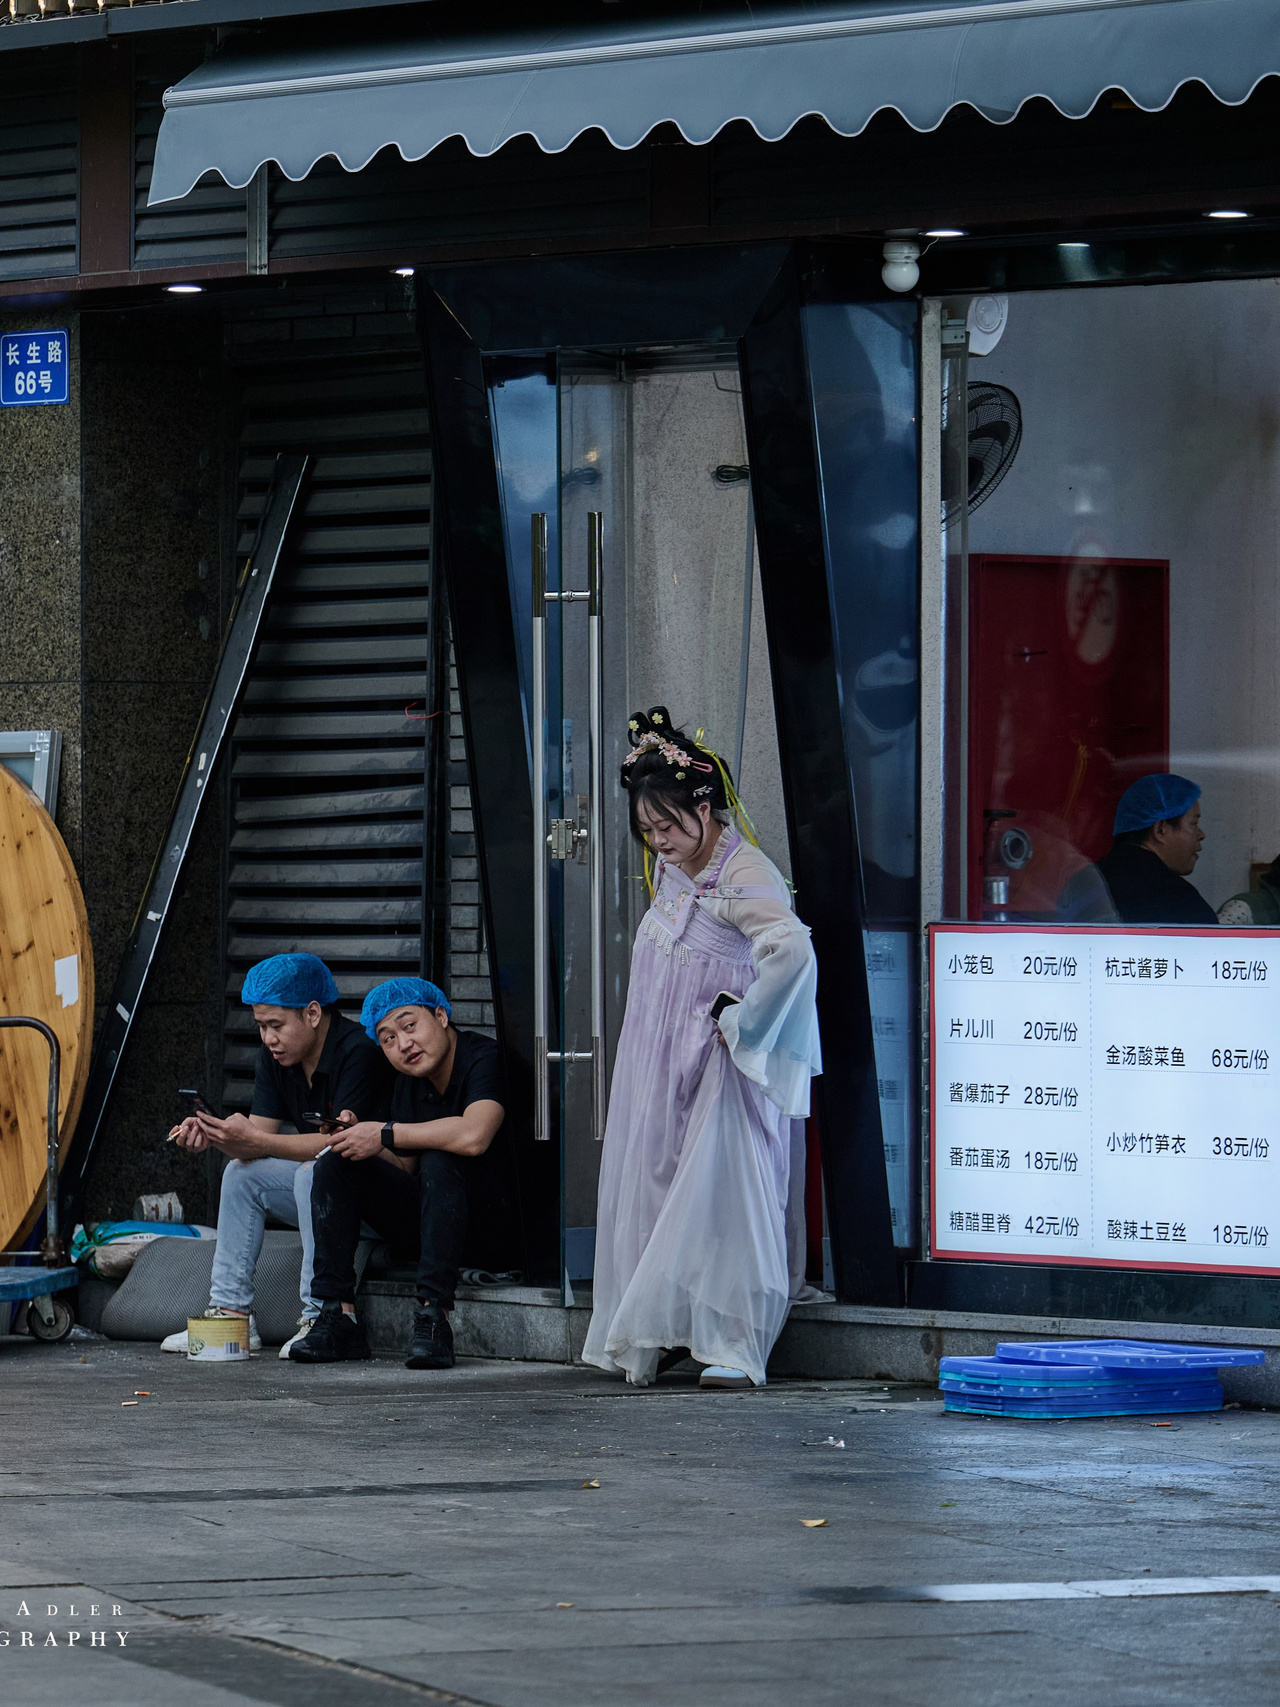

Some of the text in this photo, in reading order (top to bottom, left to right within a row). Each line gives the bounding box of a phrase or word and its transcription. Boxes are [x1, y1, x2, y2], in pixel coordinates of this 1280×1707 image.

[6, 340, 62, 366] 长生路
[15, 370, 52, 395] 66号
[949, 954, 1078, 977] 小笼包 20元/份
[1105, 957, 1268, 981] 杭式酱萝卜 18元/份
[949, 1018, 1078, 1042] 片儿川 20元/份
[1106, 1045, 1270, 1070] 金汤酸菜鱼 68元/份
[949, 1082, 1079, 1107] 酱爆茄子 28元/份
[1106, 1132, 1270, 1158] 小炒竹笋衣 38元/份
[949, 1147, 1079, 1172] 番茄蛋汤 18元/份
[949, 1210, 1080, 1237] 糖醋里脊 42元/份
[1107, 1219, 1269, 1247] 酸辣土豆丝 18元/份
